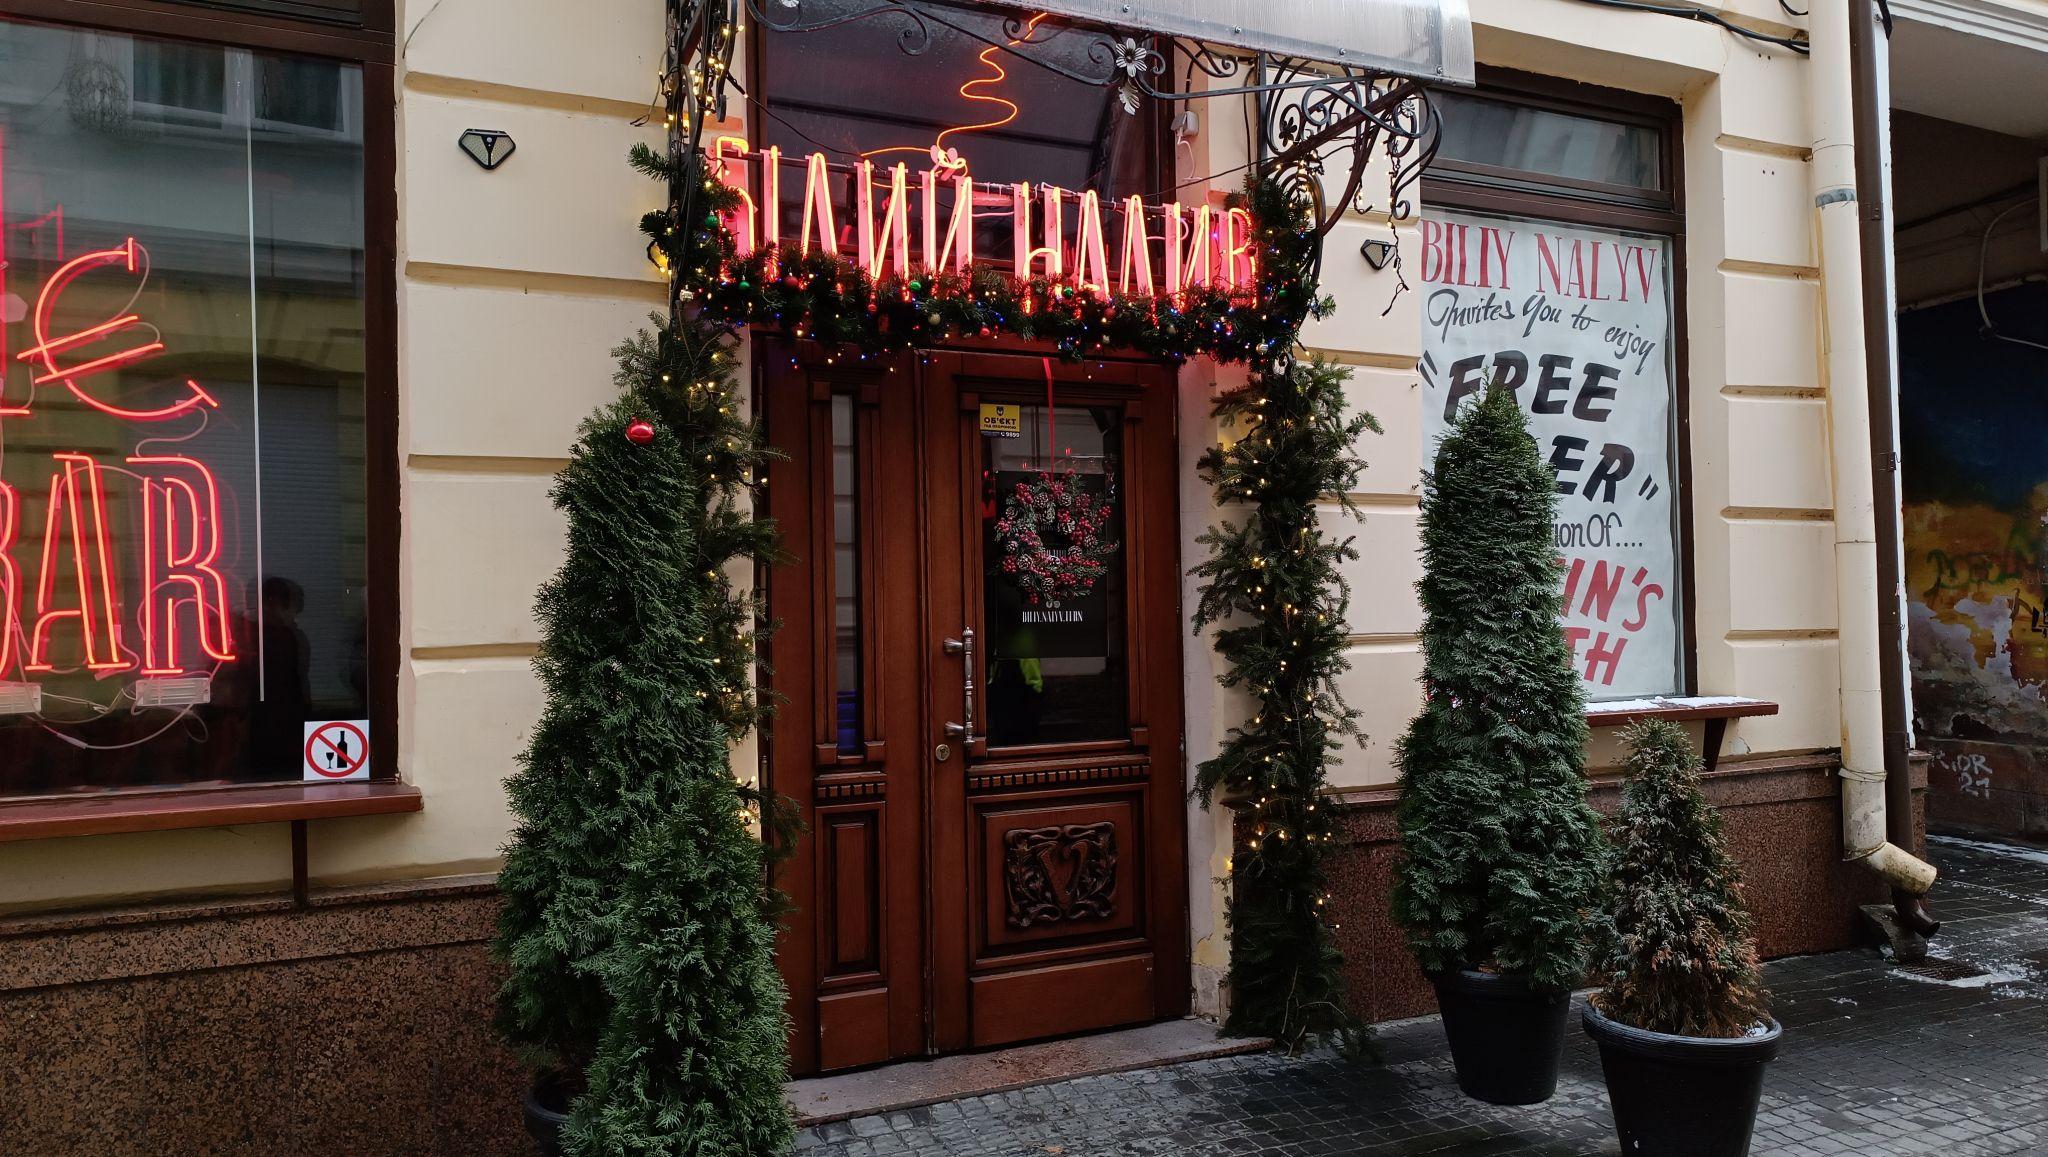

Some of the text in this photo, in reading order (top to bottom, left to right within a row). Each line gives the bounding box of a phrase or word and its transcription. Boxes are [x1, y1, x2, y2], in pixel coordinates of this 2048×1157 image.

[1421, 219, 1657, 304] BILIY NALYV
[1428, 288, 1515, 344] Invites
[1571, 304, 1600, 331] to
[1604, 324, 1655, 376] enjoy
